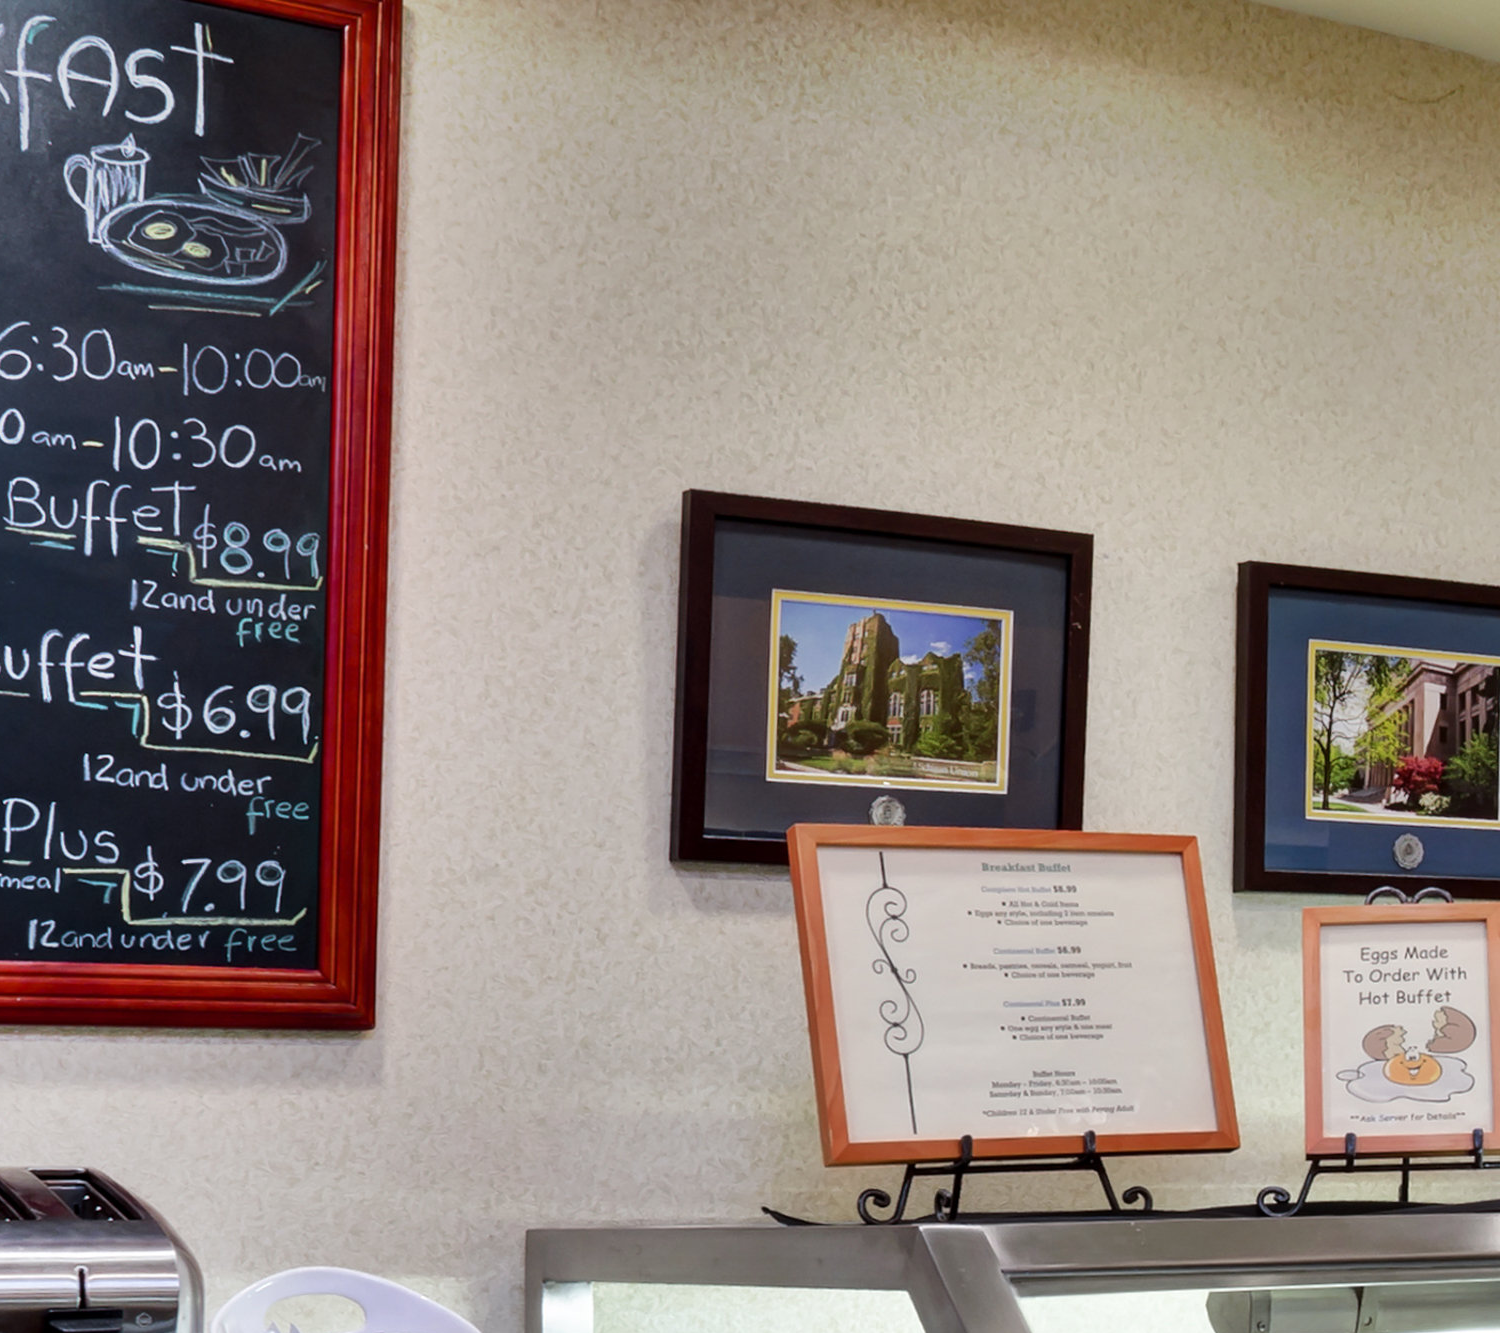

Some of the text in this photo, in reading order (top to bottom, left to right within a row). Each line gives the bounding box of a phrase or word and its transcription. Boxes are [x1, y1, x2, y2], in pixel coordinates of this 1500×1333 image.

[193, 503, 321, 581] $8.99
[226, 594, 318, 622] under
[236, 618, 301, 648] free
[156, 670, 312, 744] $6.99
[180, 769, 273, 797] under
[2, 796, 121, 865] Plus
[245, 796, 311, 836] free
[133, 845, 287, 914] $7.99
[981, 862, 1071, 873] Breakfast Buffet
[120, 927, 210, 951] under
[224, 928, 298, 960] free
[1359, 946, 1449, 965] Eggs Made
[1342, 967, 1468, 983] To Order With
[1358, 990, 1452, 1005] Hot Buffet
[1378, 1113, 1408, 1122] Server
[1410, 1112, 1424, 1121] for
